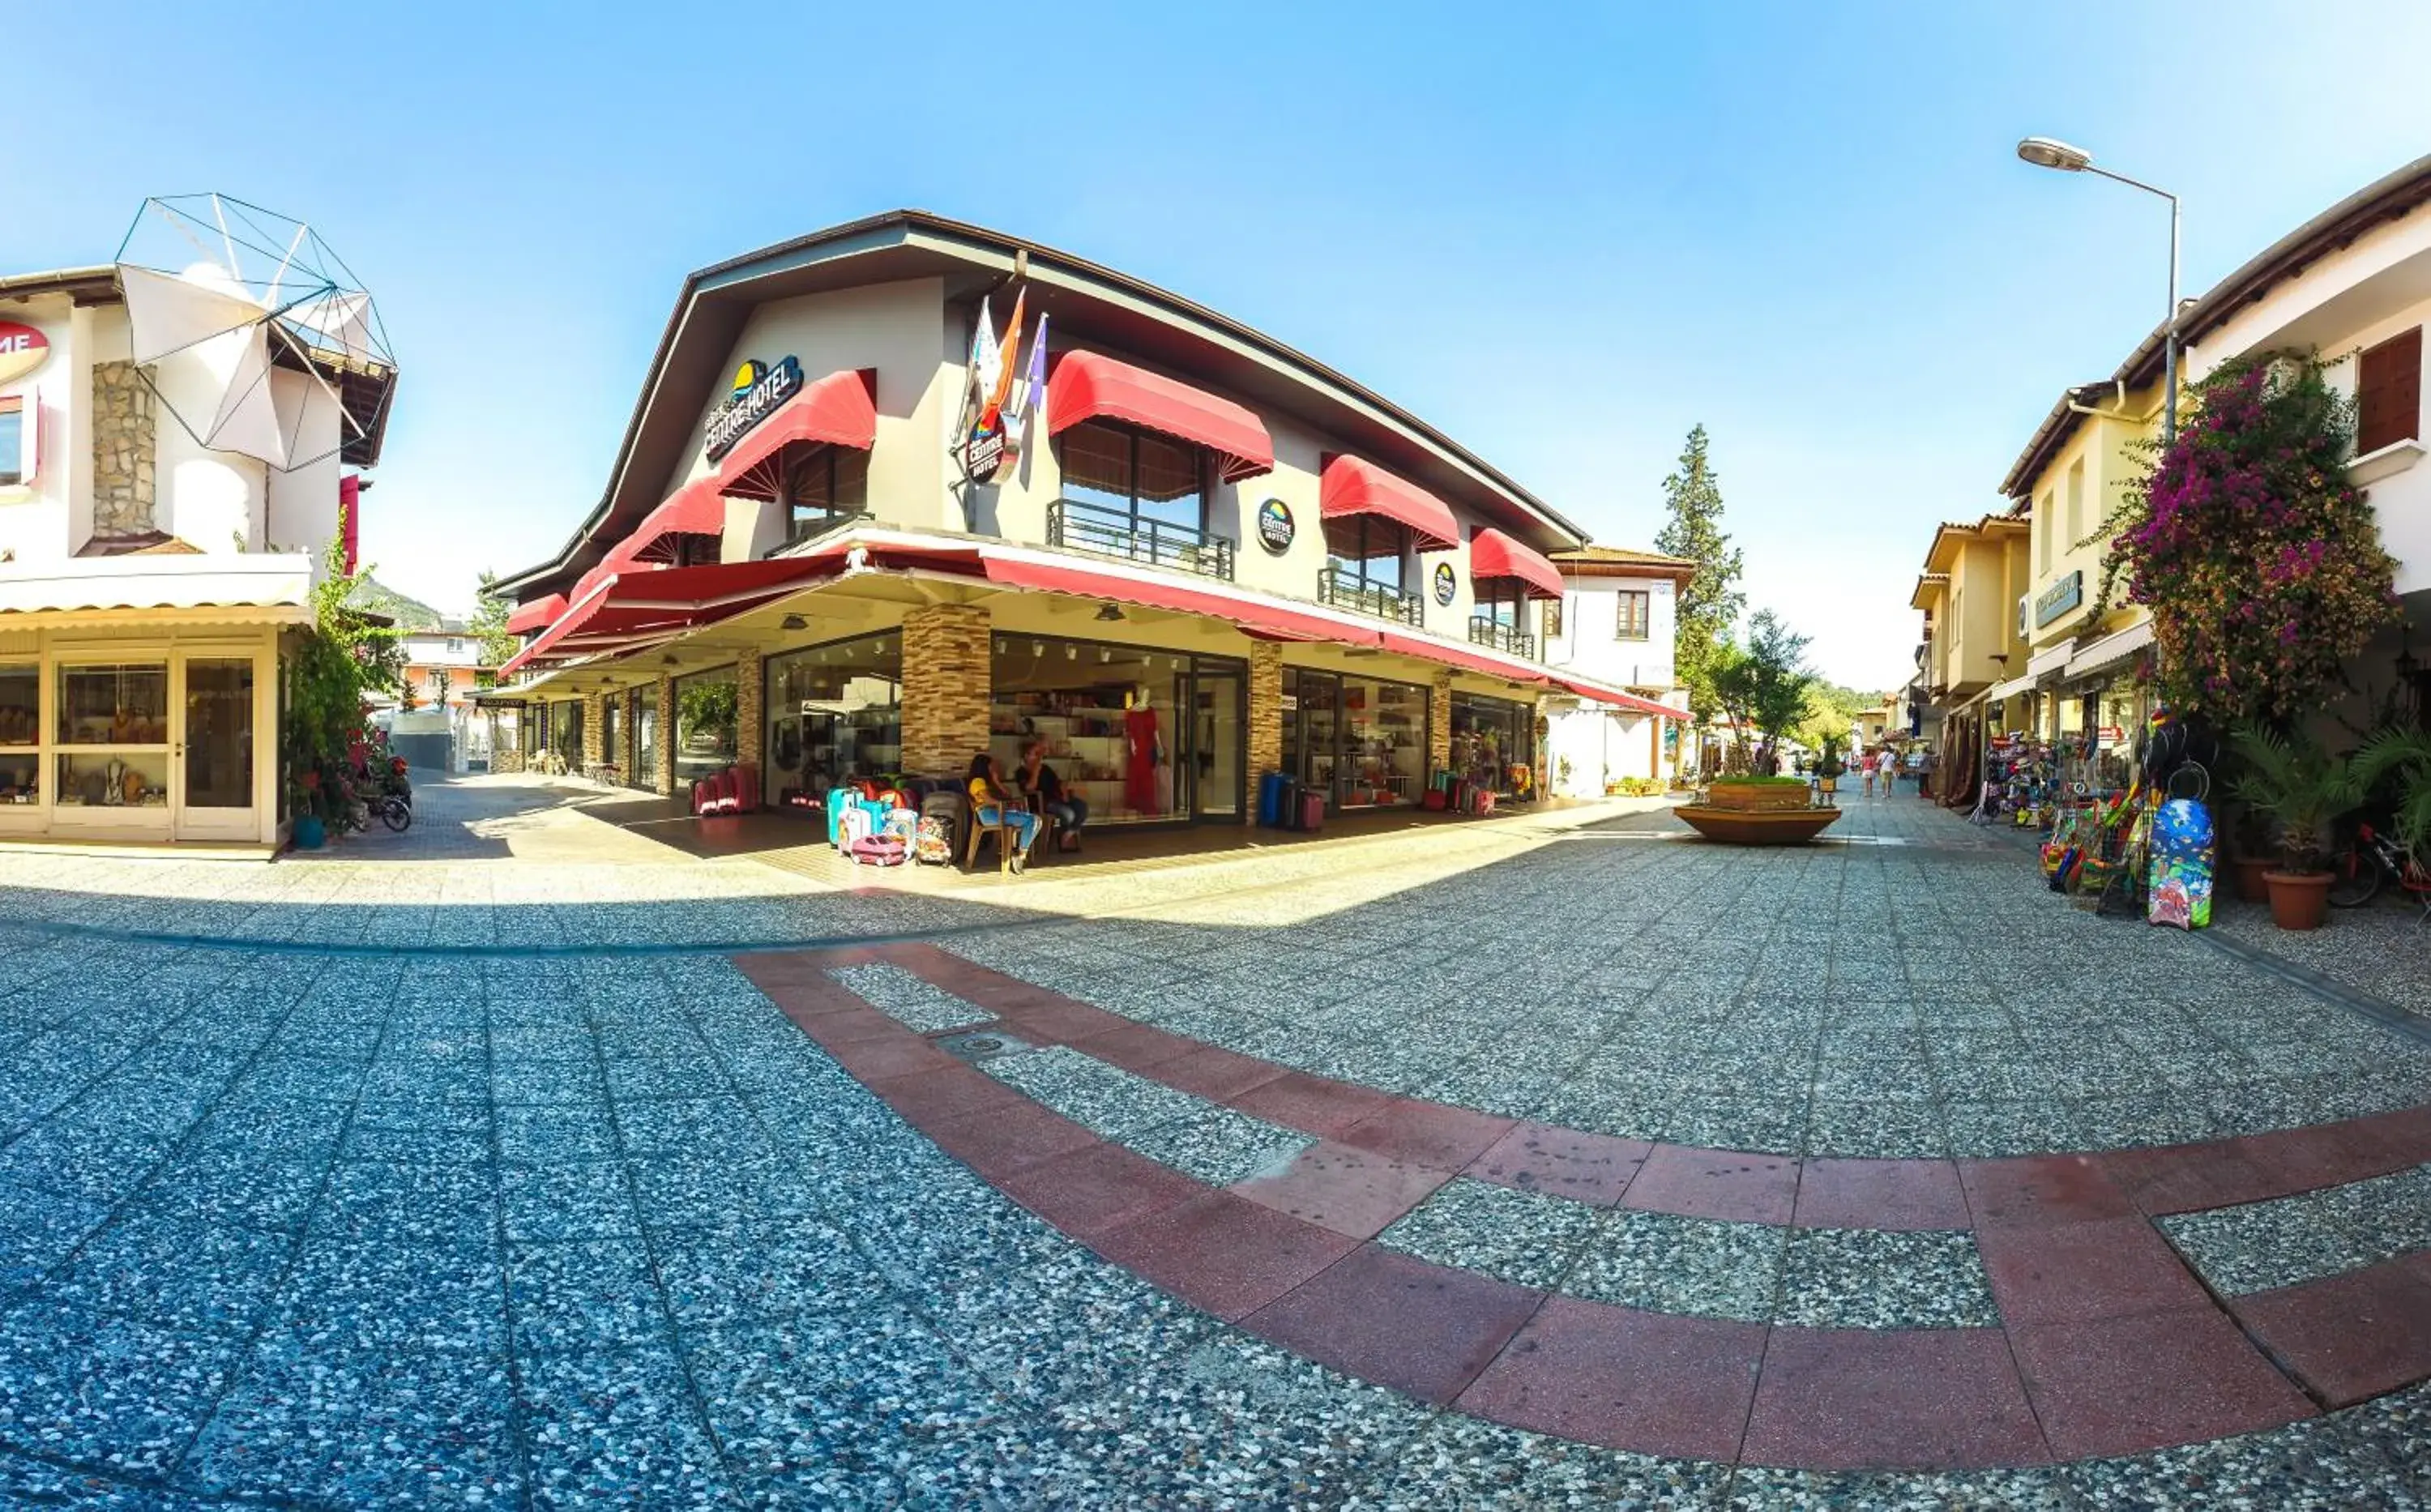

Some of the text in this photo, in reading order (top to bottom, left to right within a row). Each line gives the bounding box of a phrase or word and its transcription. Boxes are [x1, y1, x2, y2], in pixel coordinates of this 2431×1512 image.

[704, 399, 747, 453] CENTRE
[747, 365, 790, 416] HOTEL
[970, 433, 1002, 463] CENTRE
[973, 455, 999, 477] HOTEL
